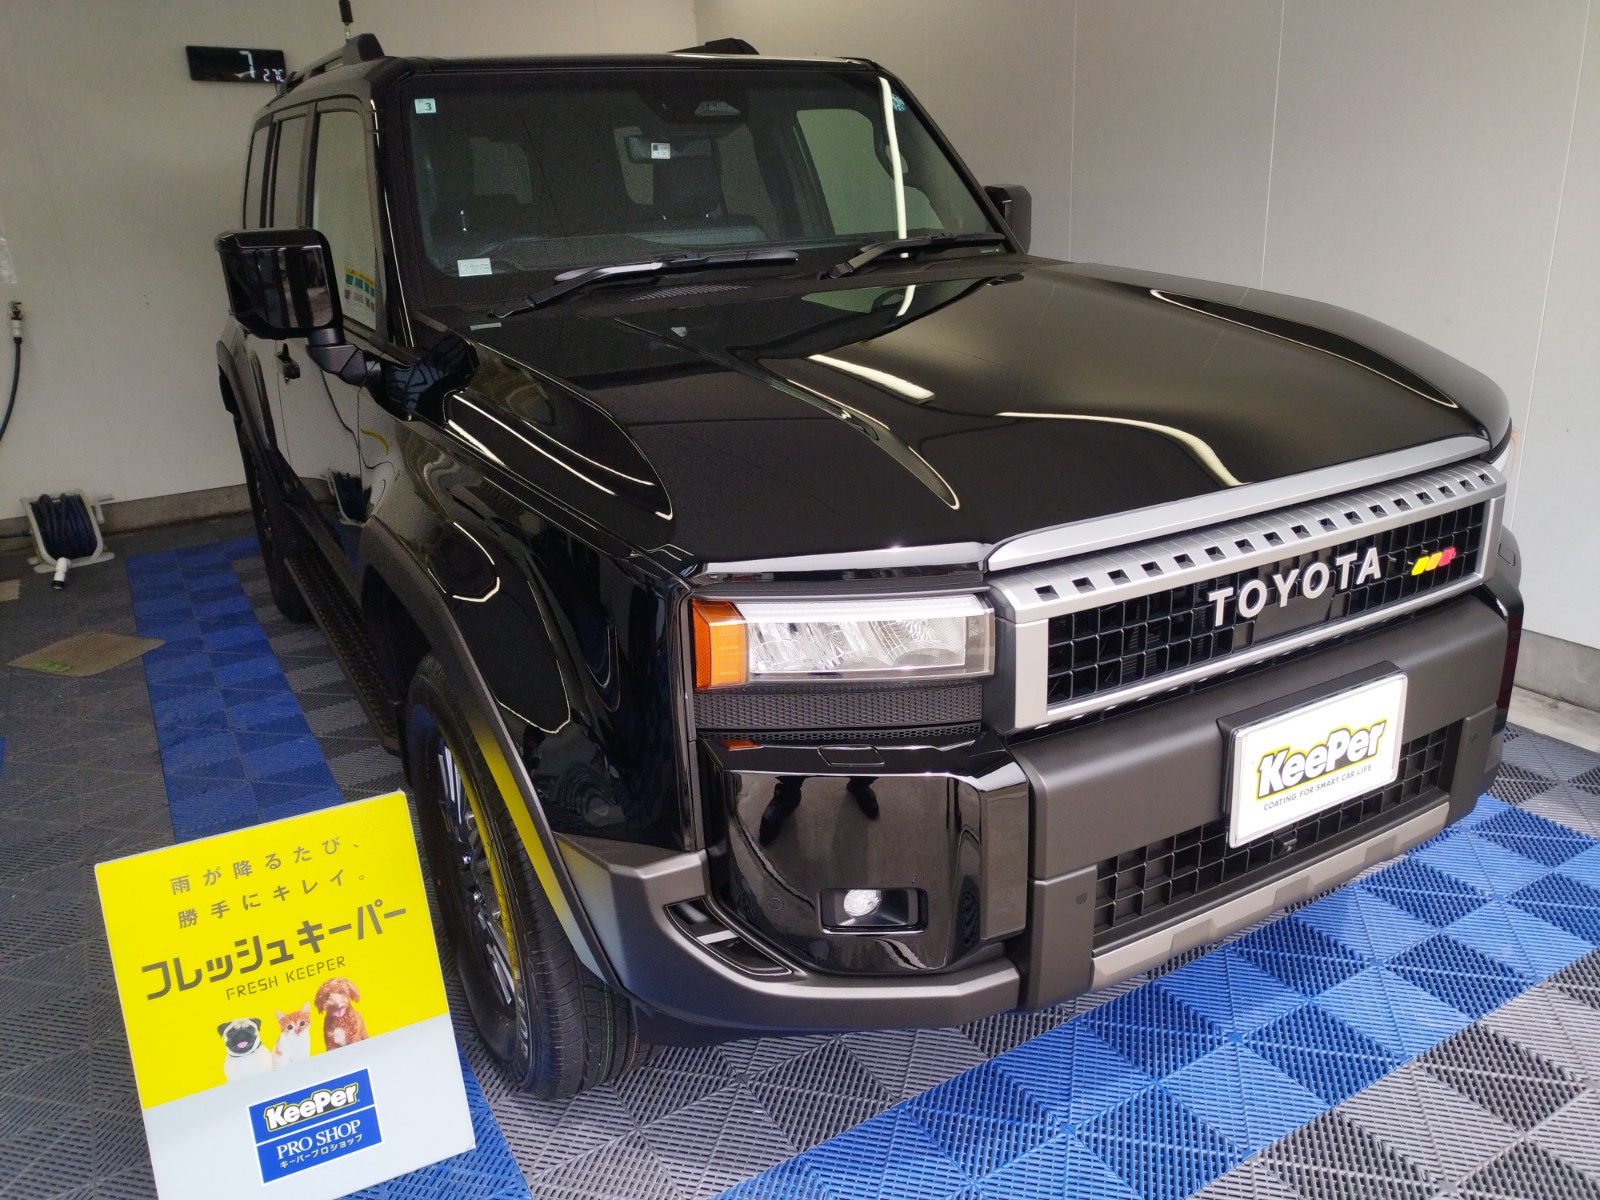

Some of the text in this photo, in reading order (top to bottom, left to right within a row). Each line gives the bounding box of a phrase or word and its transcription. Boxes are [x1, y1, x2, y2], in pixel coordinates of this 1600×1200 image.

[1207, 547, 1382, 627] TOYOTA
[1256, 718, 1387, 800] KeePer
[1263, 764, 1373, 811] COATING FOR SMART CAR LIFE
[170, 836, 359, 896] 雨が降るたび、
[177, 868, 365, 929] 勝手にキレイ。
[141, 898, 407, 1001] フレッシュキーパー
[225, 955, 347, 1001] FRESH KEEPER
[264, 1082, 359, 1132] KeePer
[276, 1119, 361, 1160] PRO SHOP
[280, 1133, 363, 1168] キーパープロショップ
